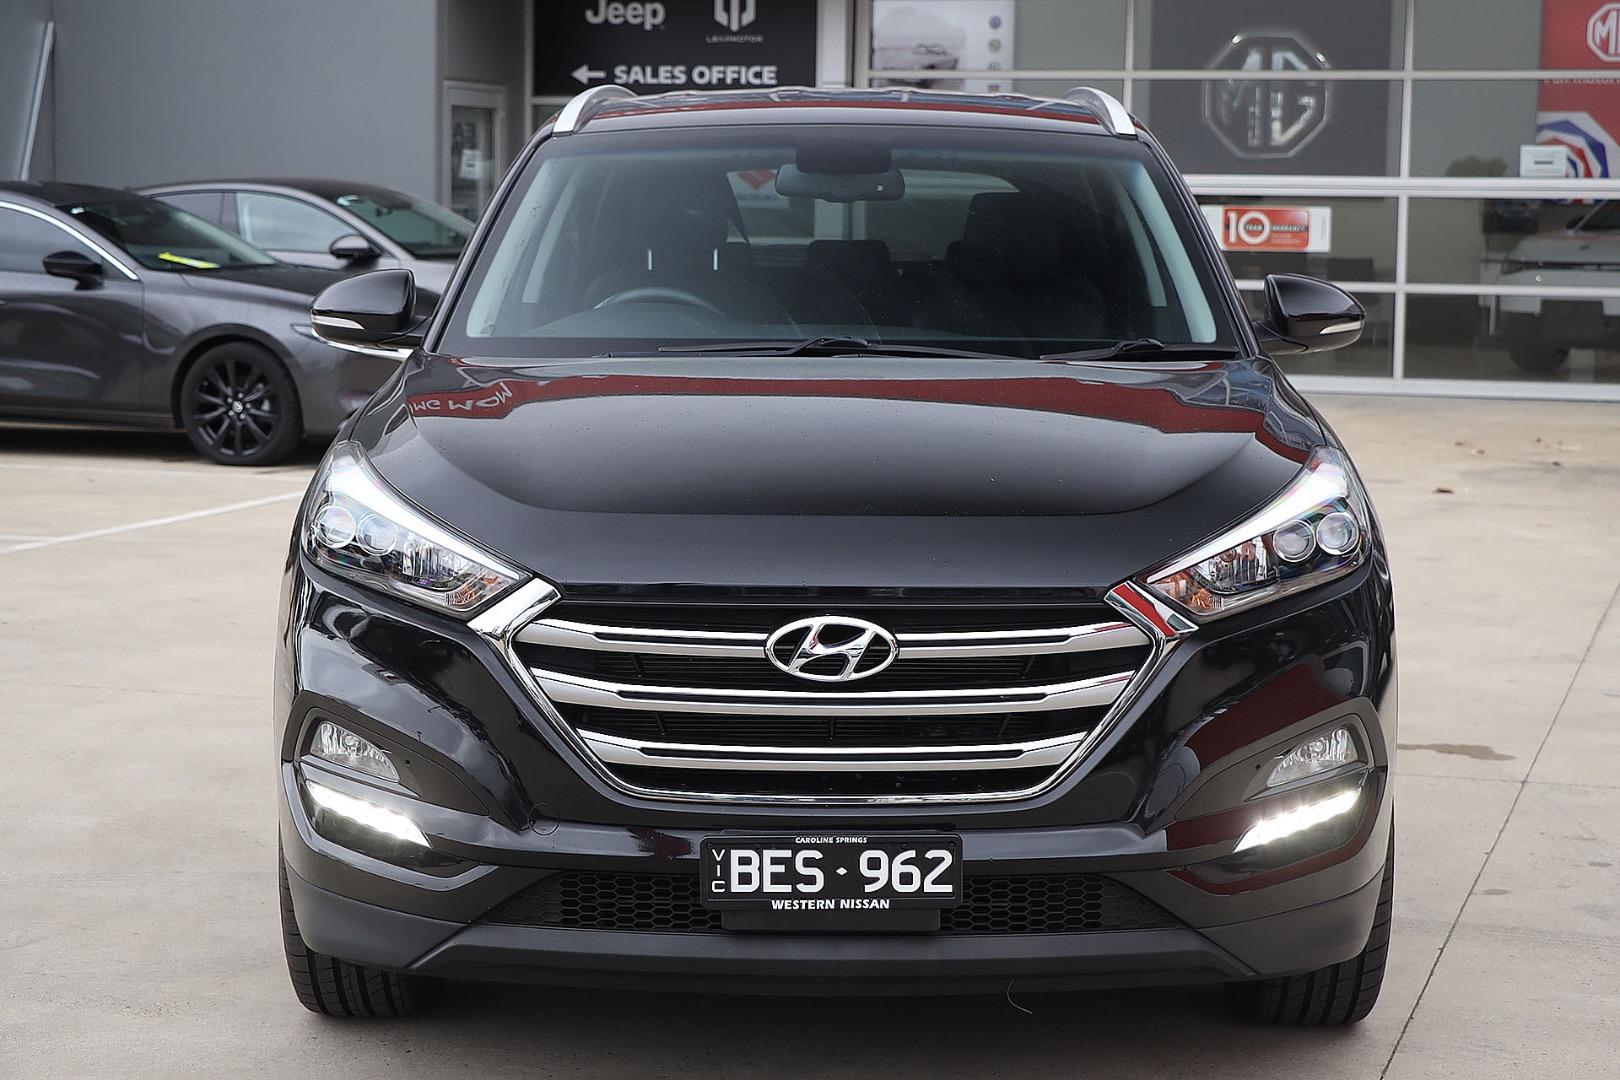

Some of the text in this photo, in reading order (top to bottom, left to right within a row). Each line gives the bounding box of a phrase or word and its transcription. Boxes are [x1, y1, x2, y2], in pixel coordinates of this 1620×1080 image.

[585, 0, 665, 30] Jeep
[613, 65, 778, 85] SALES OFFICE
[1227, 210, 1271, 245] 10
[795, 836, 868, 844] CAROLINE SPRINGS
[711, 849, 726, 893] VIC
[730, 849, 954, 893] BES 962
[771, 898, 890, 910] WESTERN NISSAN
